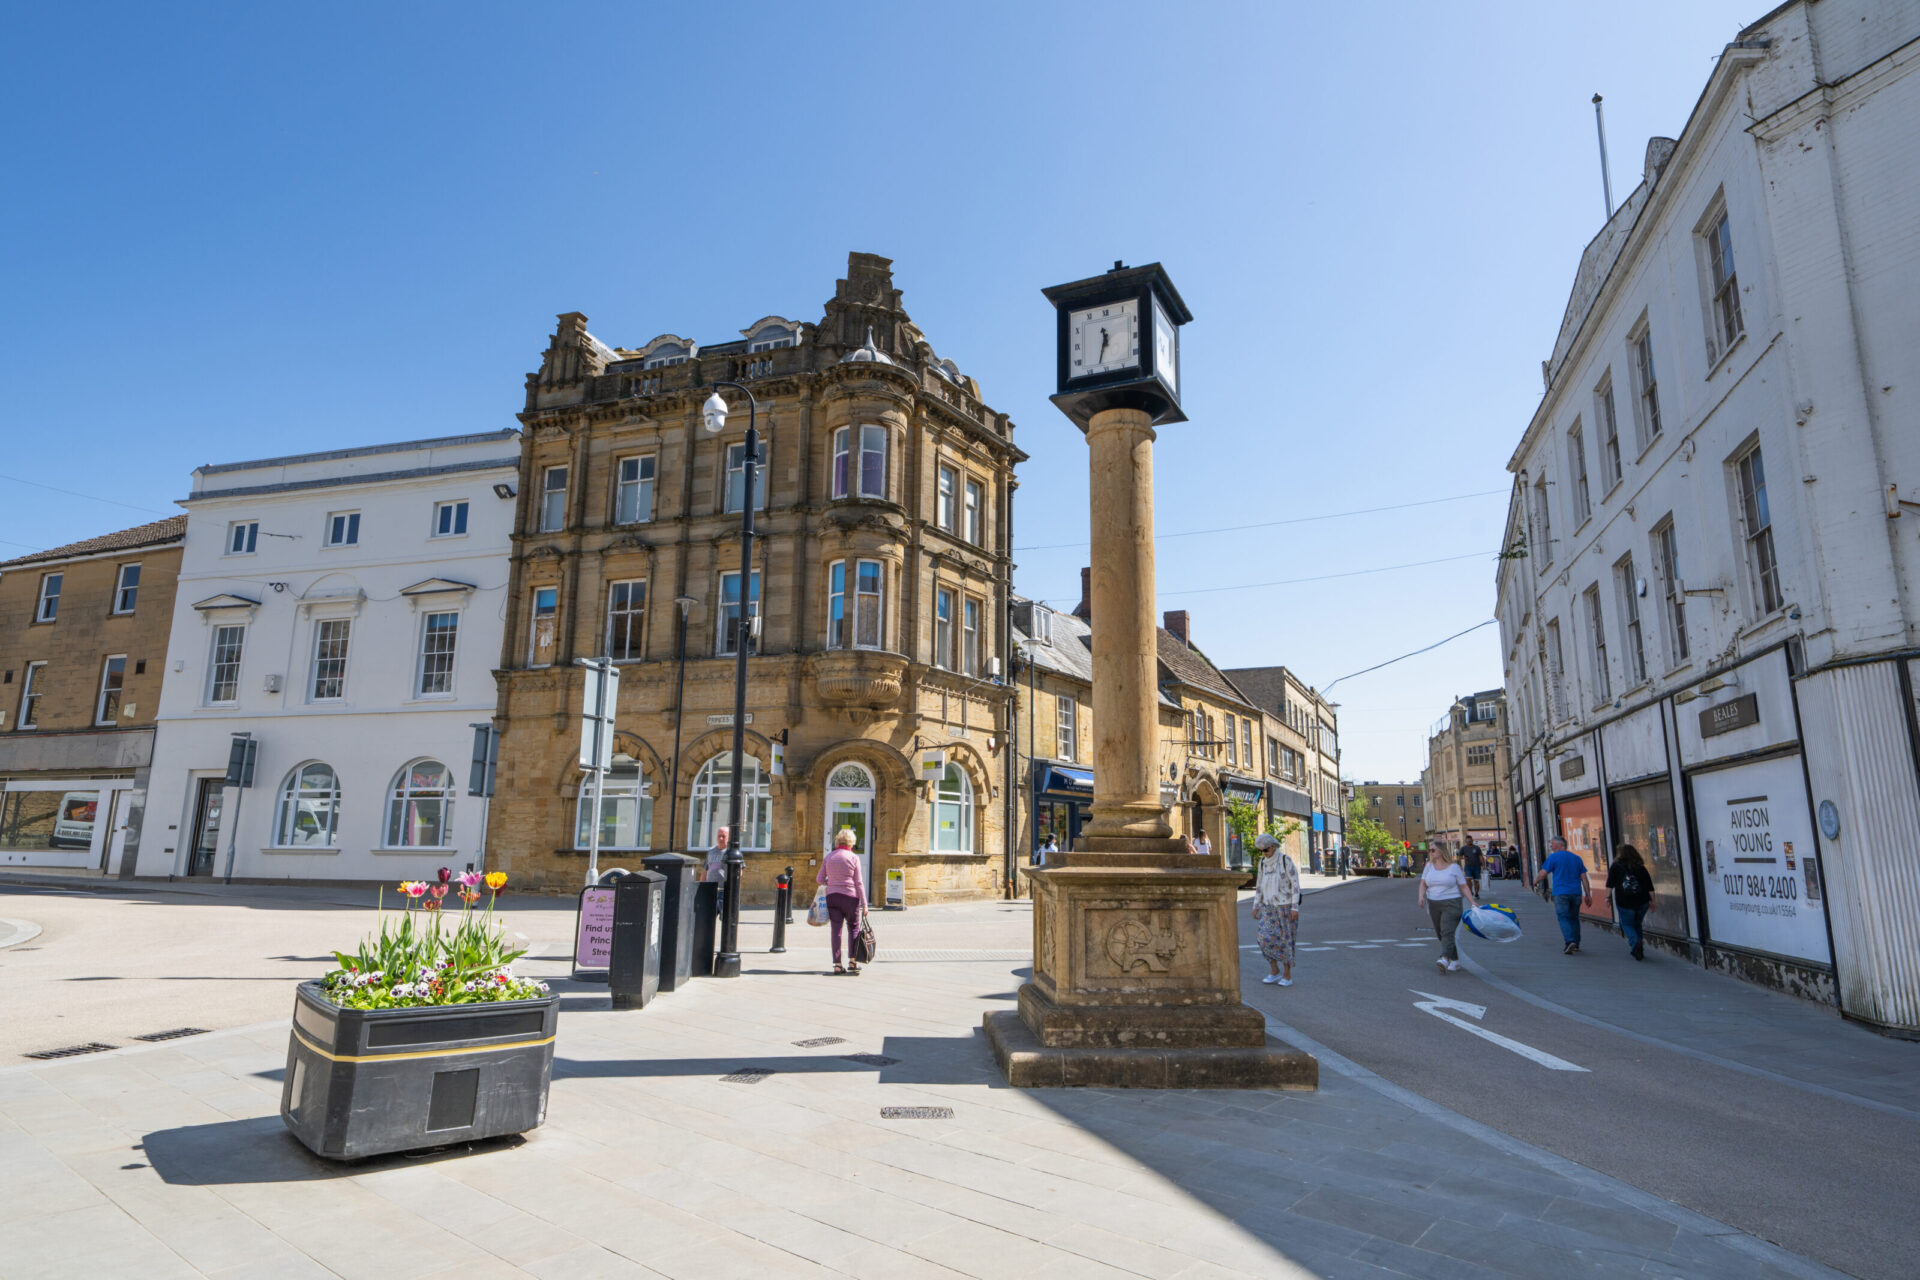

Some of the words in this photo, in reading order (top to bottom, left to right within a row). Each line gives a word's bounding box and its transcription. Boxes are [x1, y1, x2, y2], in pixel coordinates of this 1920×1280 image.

[1713, 703, 1738, 722] BEALES
[1731, 807, 1770, 829] AVISON
[1732, 832, 1773, 852] YOUNG
[1723, 874, 1744, 896] 0117
[1746, 875, 1767, 898] 984
[1768, 876, 1797, 900] 2400
[585, 924, 603, 933] Find
[590, 936, 611, 944] Princ
[591, 948, 611, 956] Stre
